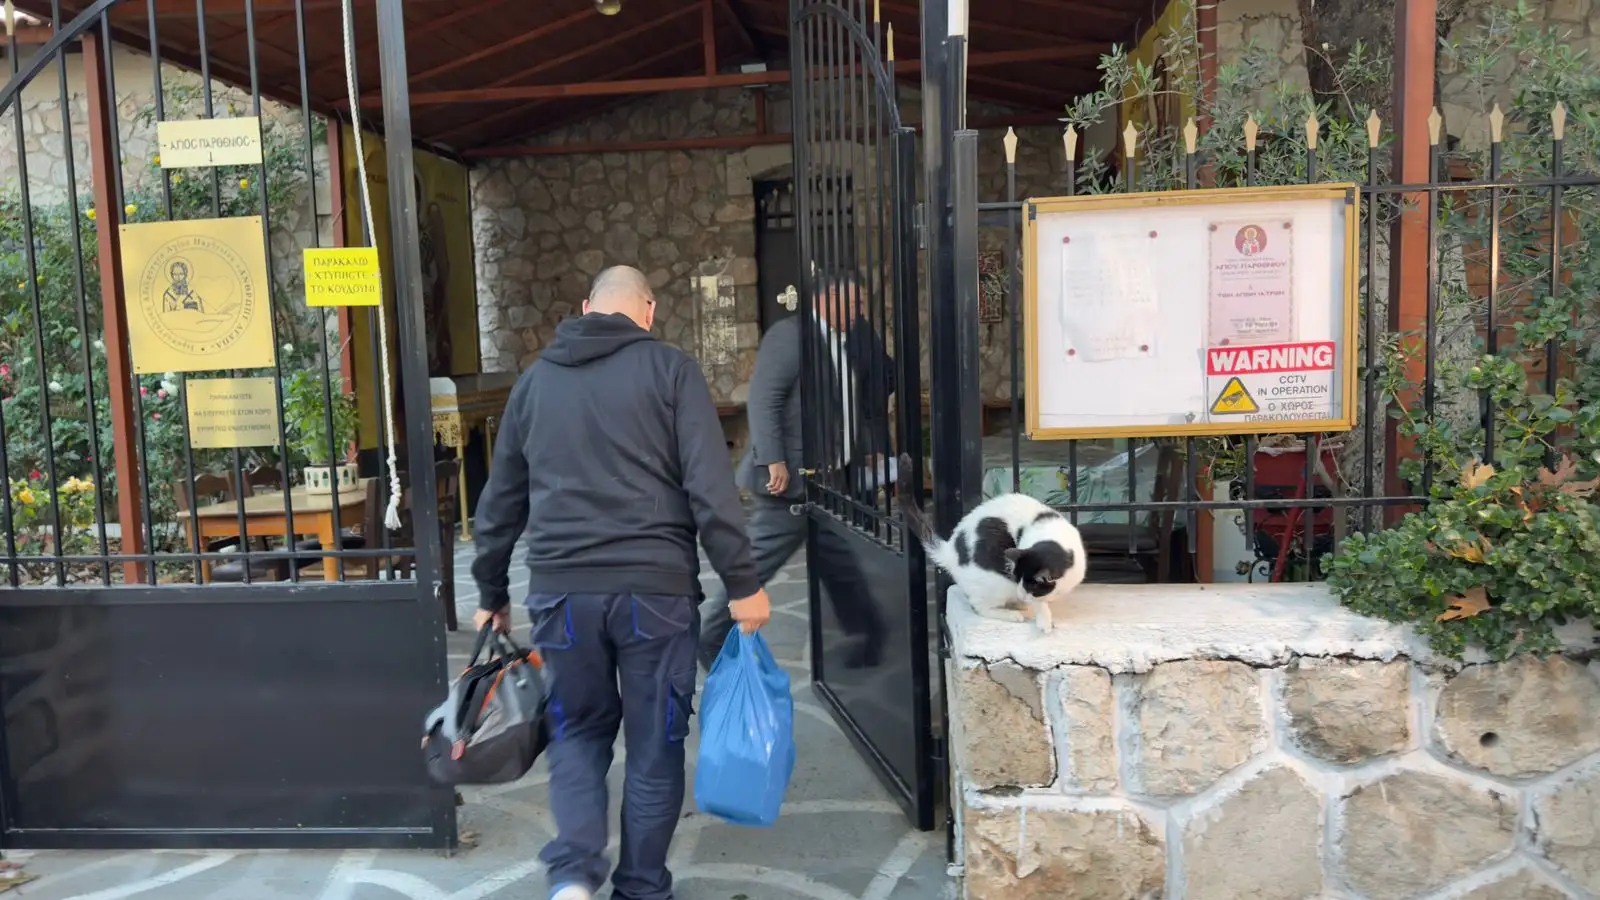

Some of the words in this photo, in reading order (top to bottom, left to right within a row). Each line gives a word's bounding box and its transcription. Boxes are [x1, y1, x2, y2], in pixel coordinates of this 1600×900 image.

[311, 285, 324, 293] ΤΟ
[1210, 345, 1333, 372] WARNING
[1279, 375, 1307, 384] CCTV
[1257, 388, 1268, 396] IN
[1271, 385, 1328, 396] OPERATION
[1280, 401, 1314, 411] ΧΩΡΟΣ
